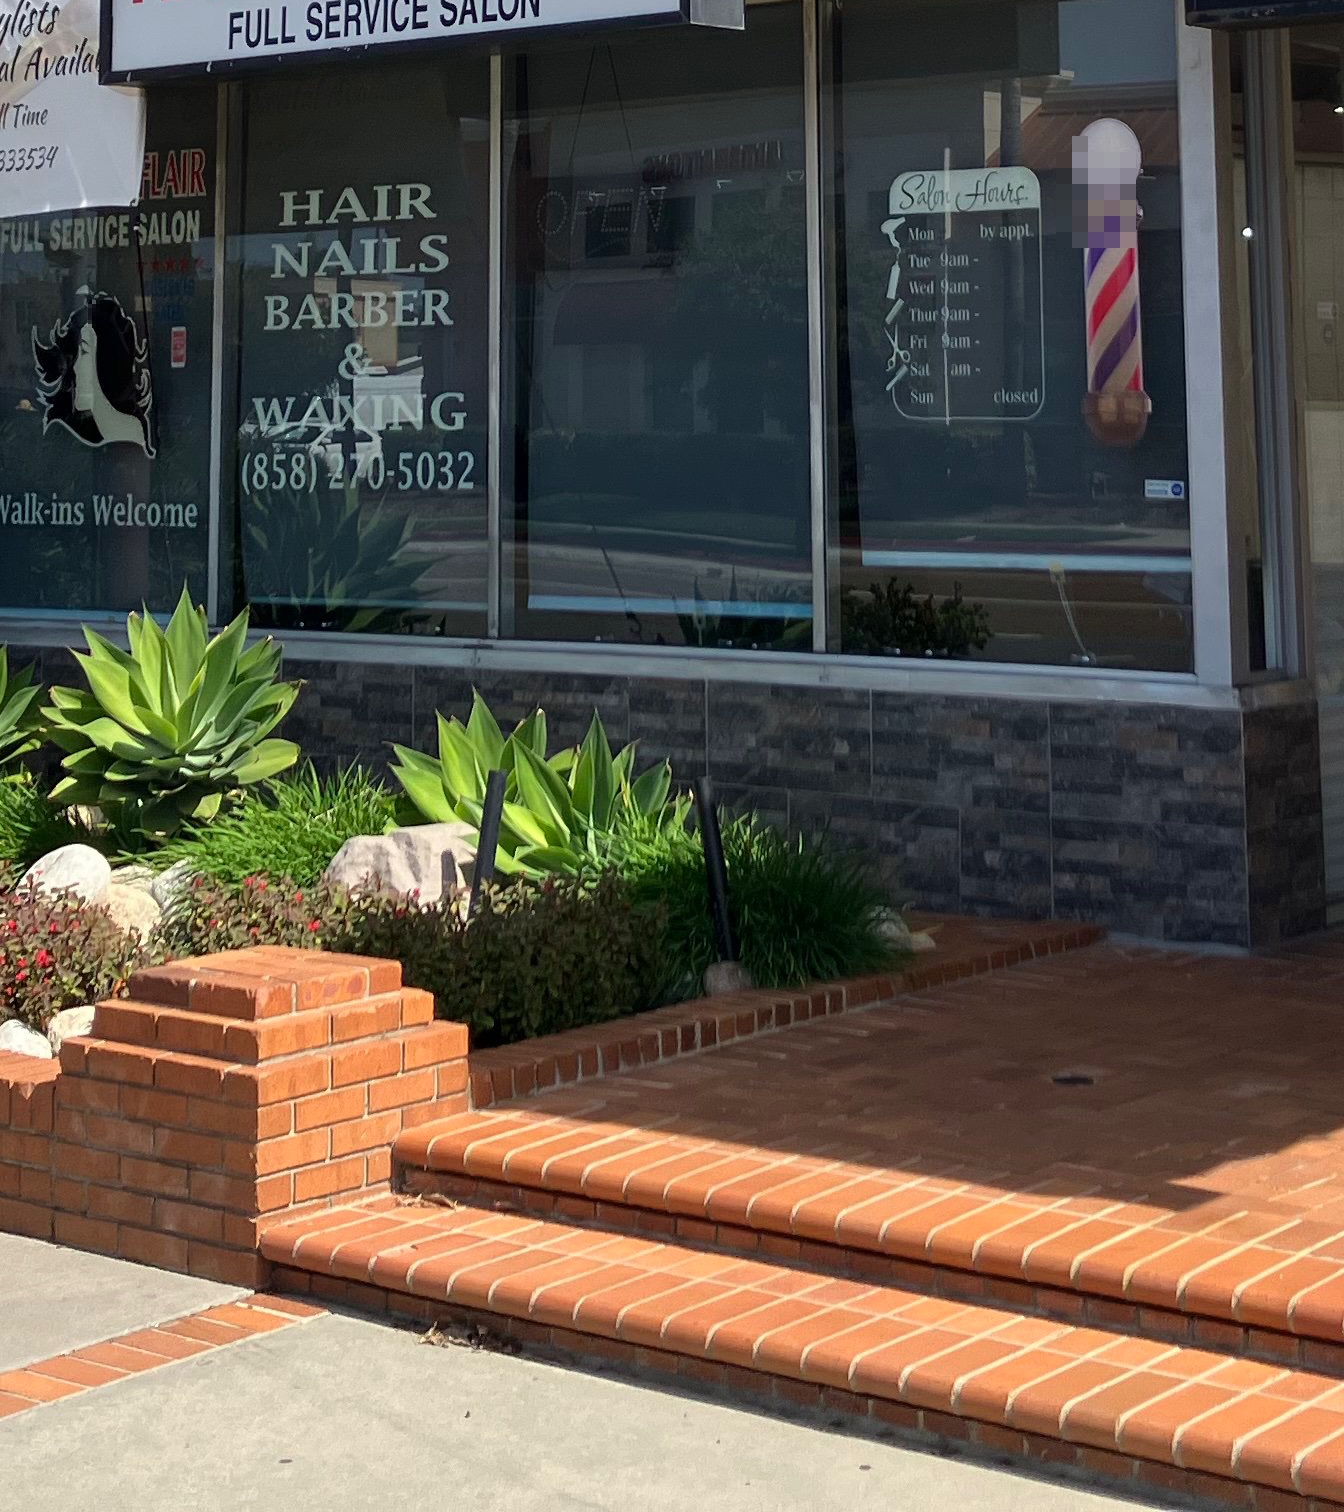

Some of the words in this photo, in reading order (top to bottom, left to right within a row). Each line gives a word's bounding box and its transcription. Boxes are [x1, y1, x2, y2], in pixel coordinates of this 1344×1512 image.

[229, 6, 295, 49] FULL
[13, 103, 48, 129] Time
[279, 183, 437, 226] HAIR
[536, 186, 665, 235] OPEN
[900, 174, 951, 211] Salon
[0, 221, 44, 254] FULL
[50, 215, 130, 251] SERVICE
[138, 210, 200, 246] SALON
[909, 228, 934, 240] Mon
[980, 224, 996, 242] by
[271, 234, 449, 278] NAILS
[908, 254, 931, 268] Tue
[940, 253, 968, 266] 9am
[910, 281, 934, 294] Wed
[941, 279, 969, 293] 9am
[264, 289, 453, 330] BARBER
[909, 308, 938, 321] Thur
[941, 307, 969, 321] 9am
[910, 335, 927, 348] Fri
[942, 333, 970, 348] 9am
[338, 343, 372, 380] &
[910, 362, 930, 376] Sat
[253, 392, 467, 431] WAXING
[910, 391, 933, 404] Sun
[994, 388, 1038, 403] closed
[241, 452, 316, 495] (858)
[328, 451, 474, 489] 270-5032
[93, 493, 197, 528] Welcome
